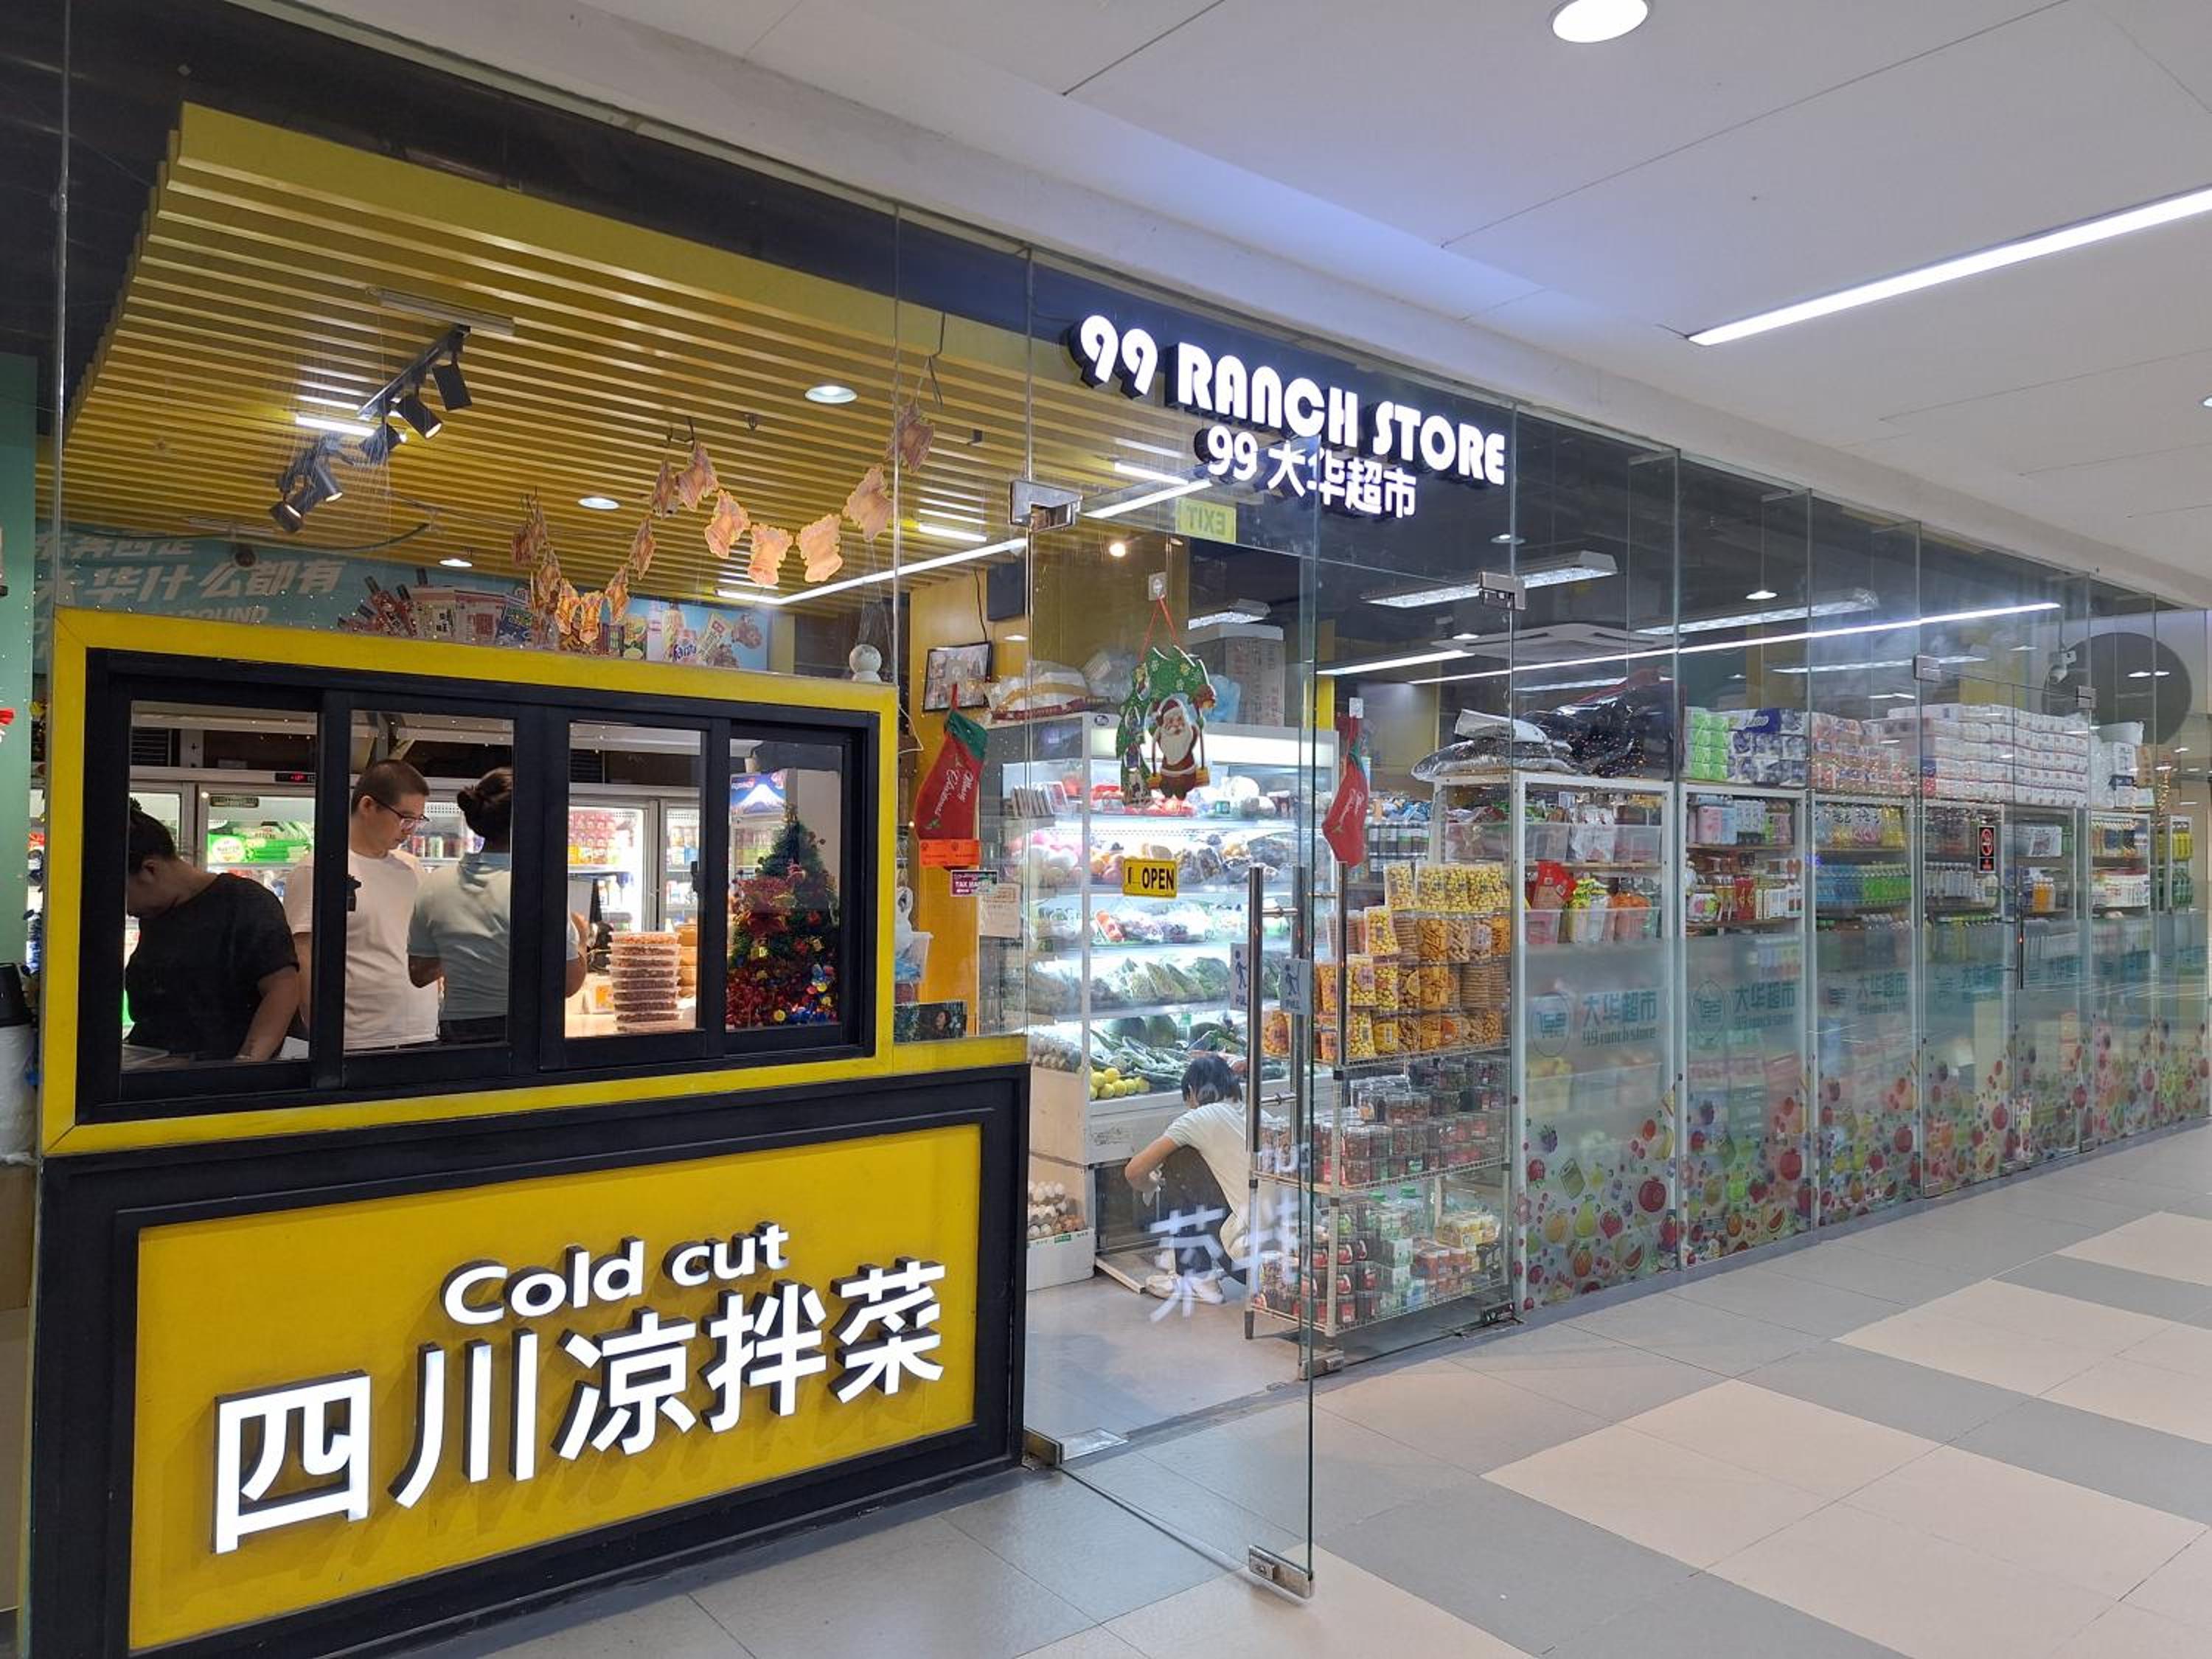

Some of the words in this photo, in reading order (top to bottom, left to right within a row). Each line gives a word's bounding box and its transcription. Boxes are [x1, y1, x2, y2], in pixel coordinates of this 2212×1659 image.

[1079, 314, 1159, 395] 99
[1178, 342, 1359, 448] RANCH
[1371, 401, 1506, 486] STORE
[1206, 425, 1259, 481] 99
[1267, 441, 1417, 519] 大华超市
[1142, 867, 1175, 890] OPEN
[1583, 991, 1657, 1026] 大华超市
[1735, 981, 1795, 1013] 大华超市
[444, 1236, 645, 1325] Cold
[671, 1222, 790, 1287] cut
[212, 1260, 946, 1554] 四川凉拌菜
